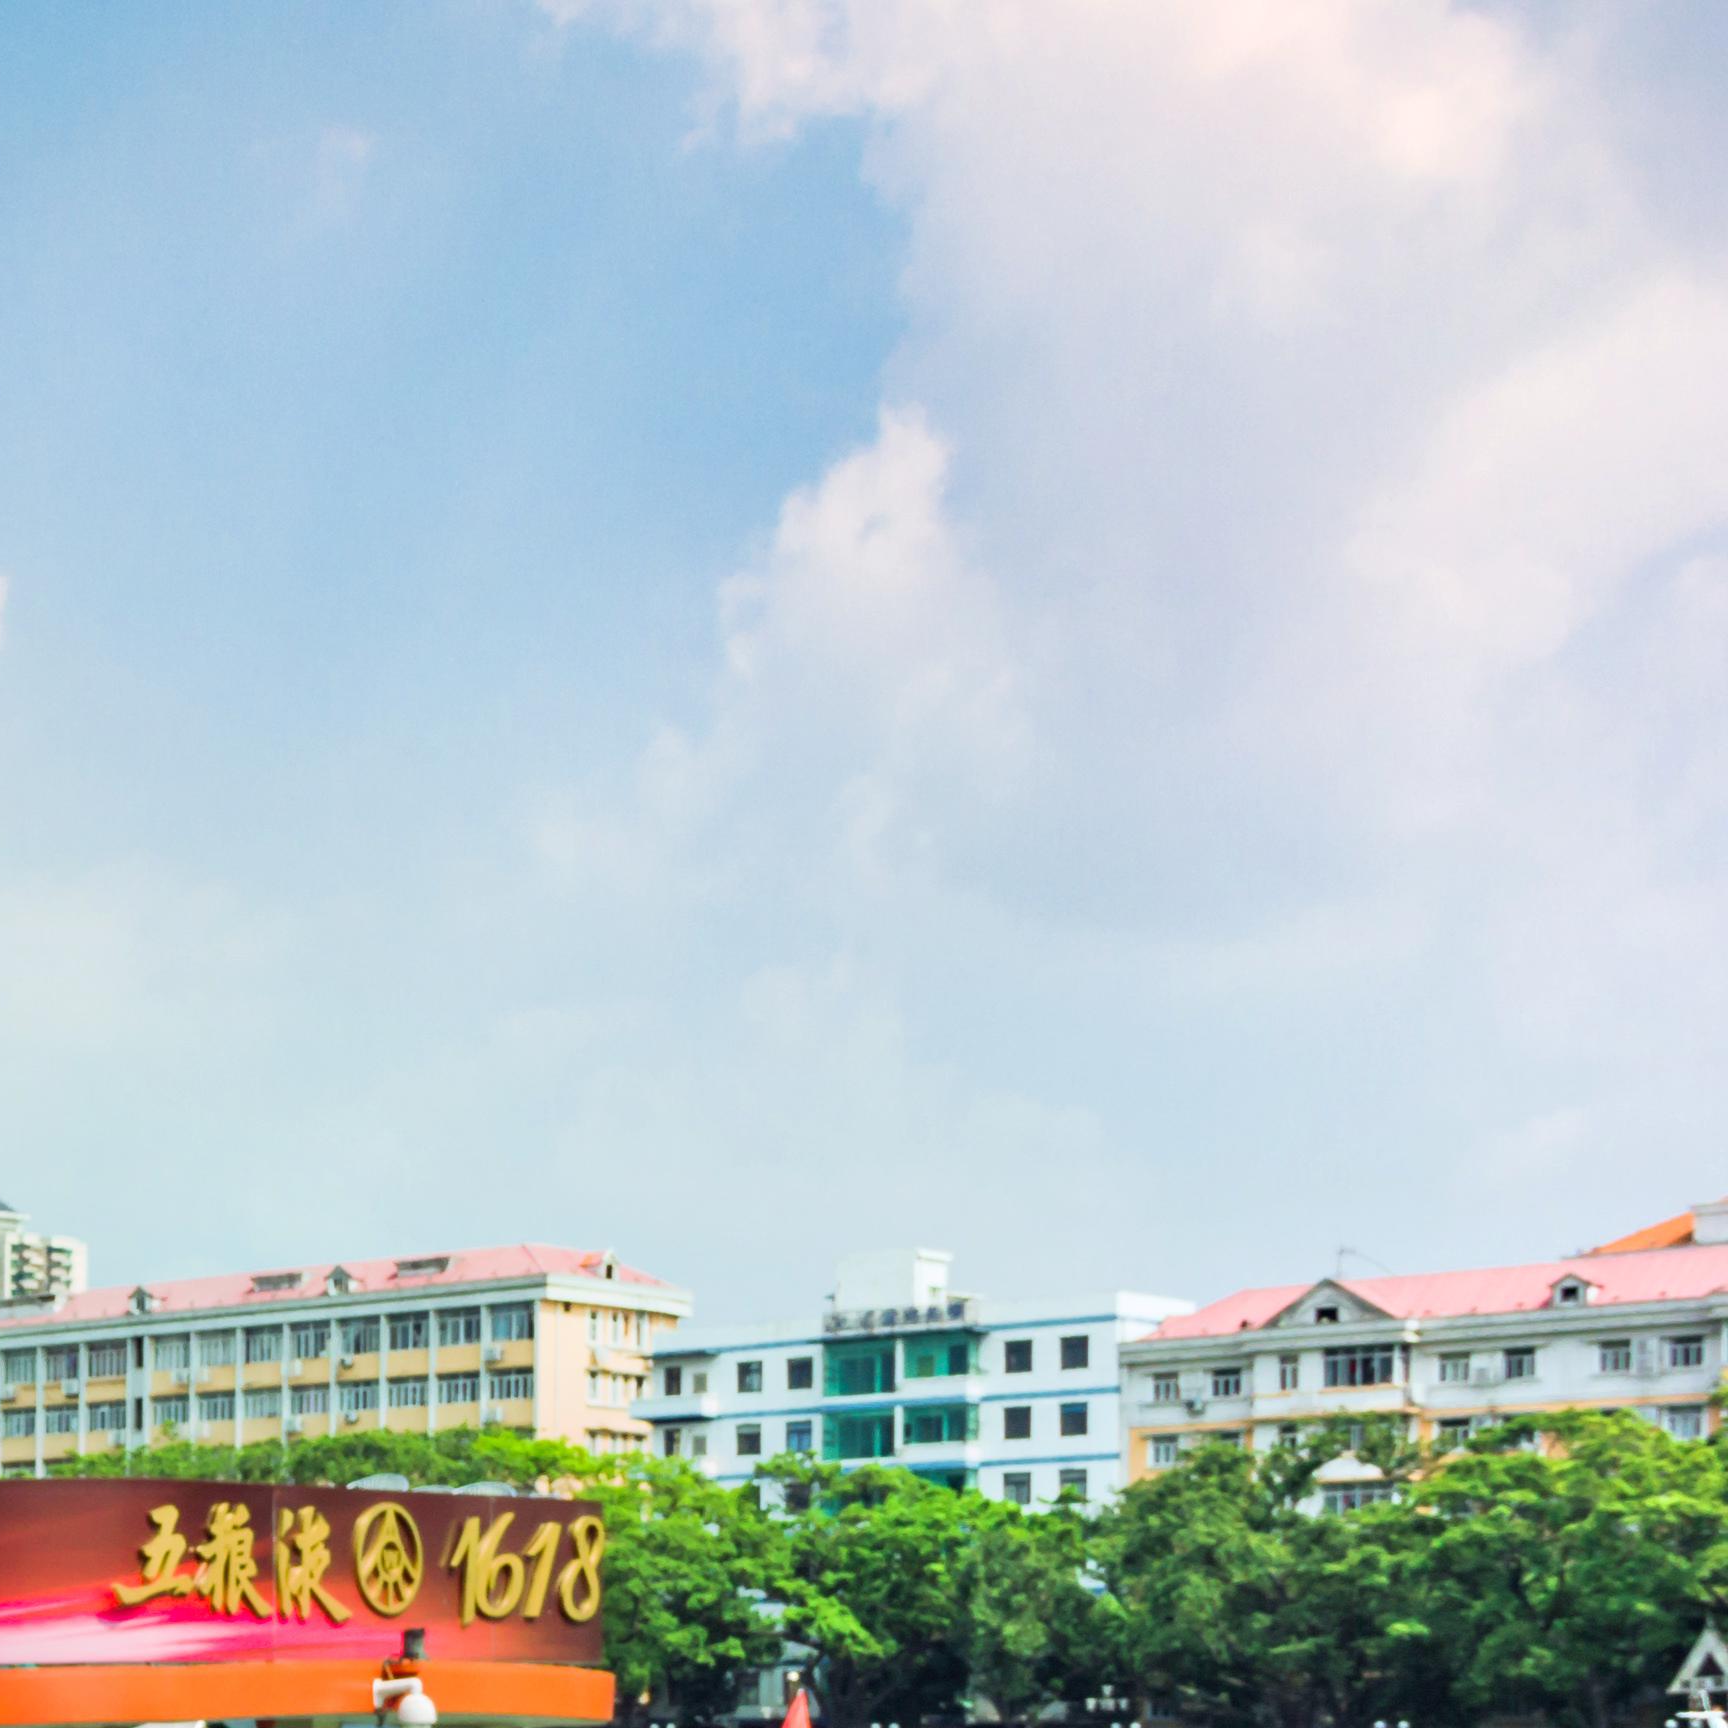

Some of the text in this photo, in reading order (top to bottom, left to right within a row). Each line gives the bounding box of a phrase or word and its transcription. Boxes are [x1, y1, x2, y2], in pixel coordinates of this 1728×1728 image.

[111, 1501, 605, 1627] 五粮液 1618
